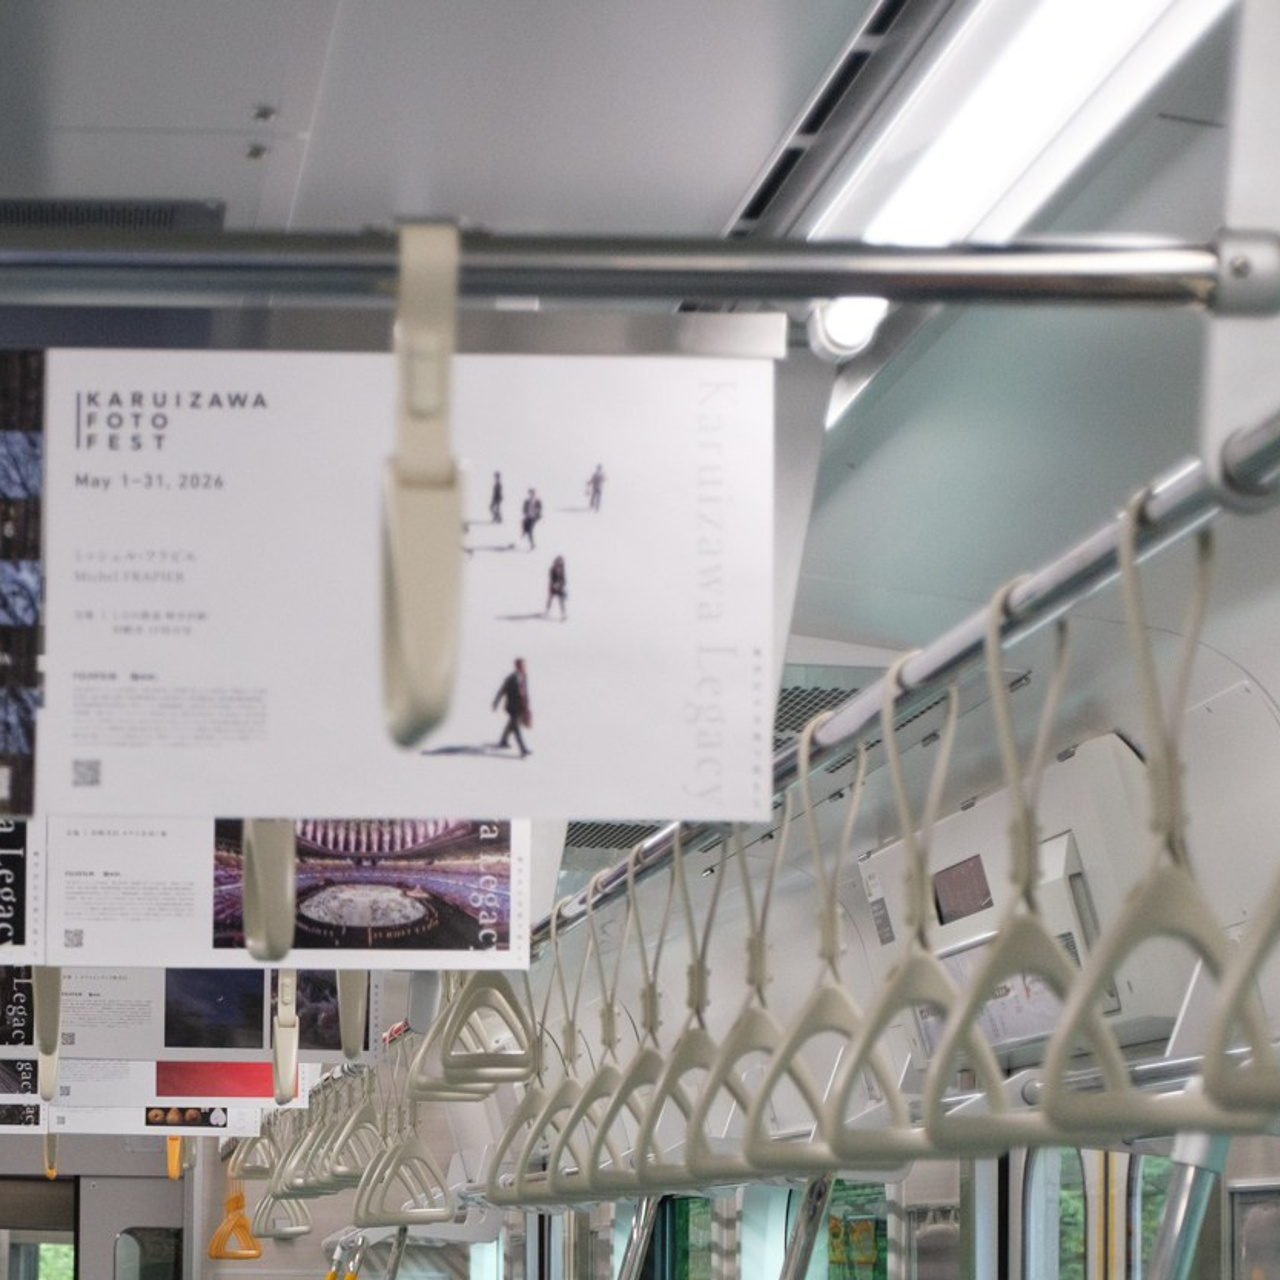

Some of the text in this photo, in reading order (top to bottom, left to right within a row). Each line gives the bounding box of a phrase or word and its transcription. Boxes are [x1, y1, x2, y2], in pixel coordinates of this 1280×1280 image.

[86, 392, 267, 409] KARUIZAWA
[86, 412, 168, 430] FOTO
[86, 434, 165, 450] FEST
[75, 473, 111, 490] May
[178, 474, 224, 490] 2026
[682, 378, 739, 807] Karuizawa Legacy
